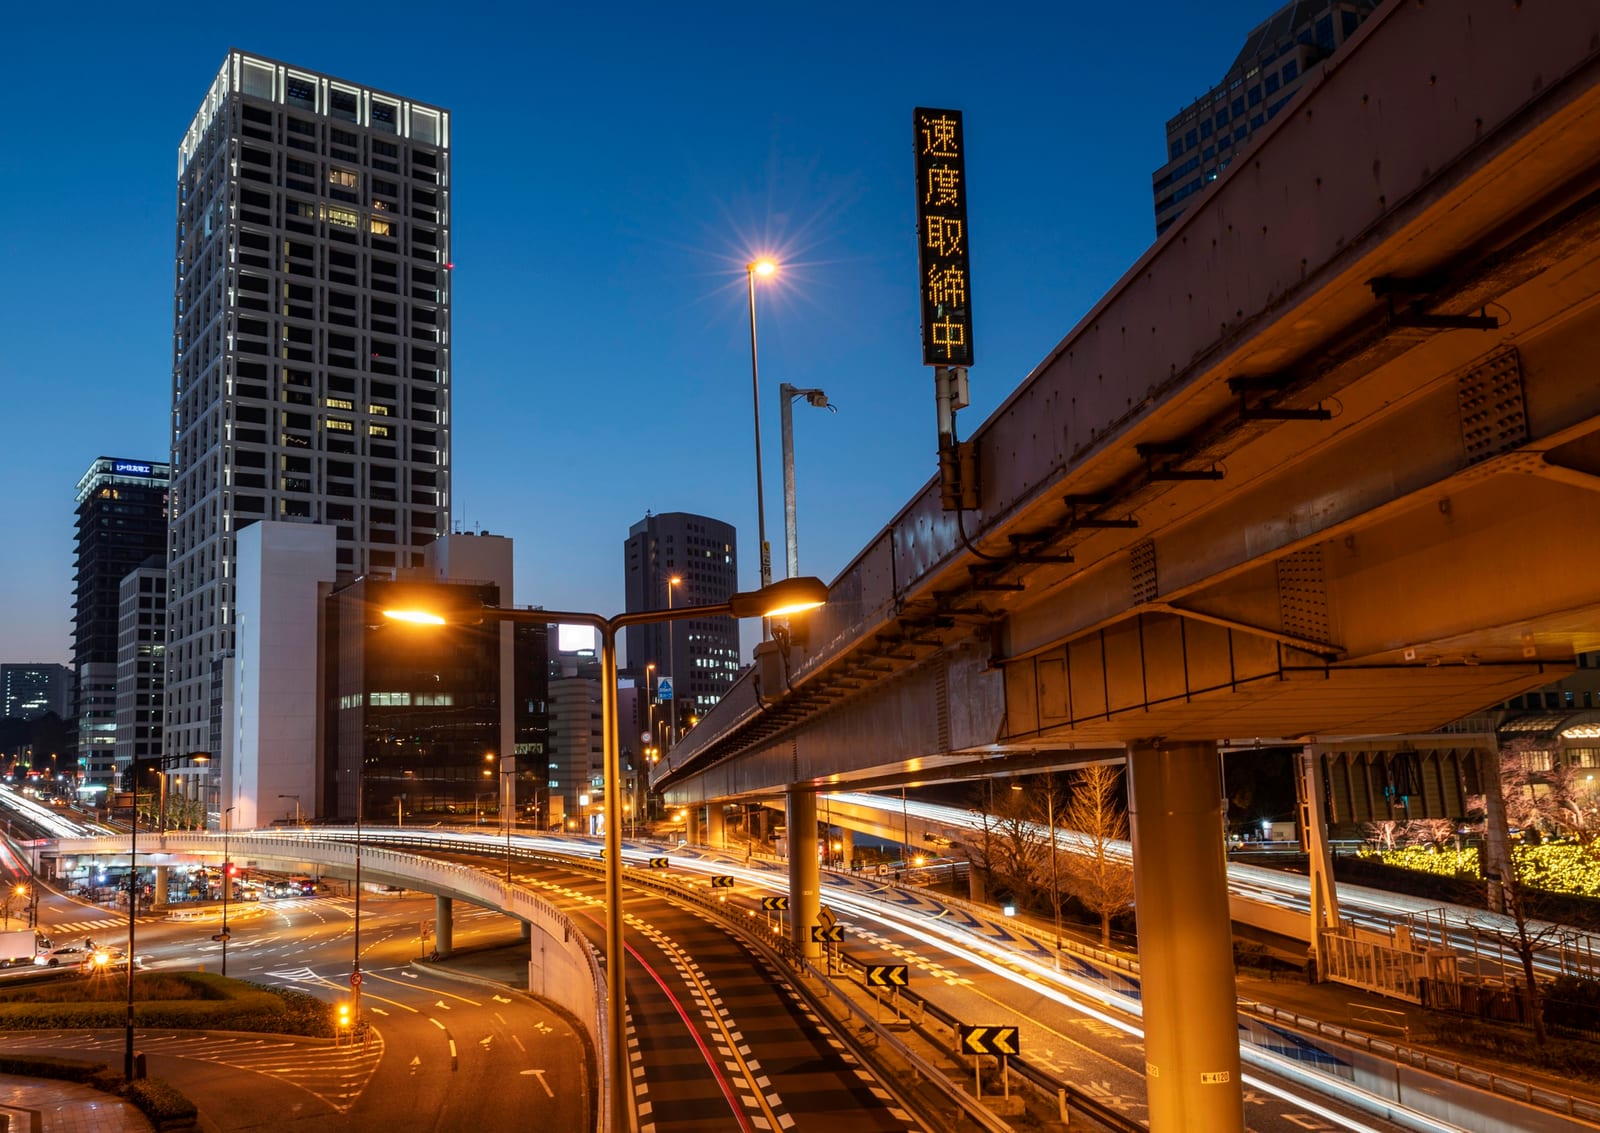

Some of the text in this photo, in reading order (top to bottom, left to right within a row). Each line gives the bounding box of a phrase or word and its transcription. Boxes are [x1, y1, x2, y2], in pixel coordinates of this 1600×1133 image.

[921, 114, 965, 359] 速度取締中
